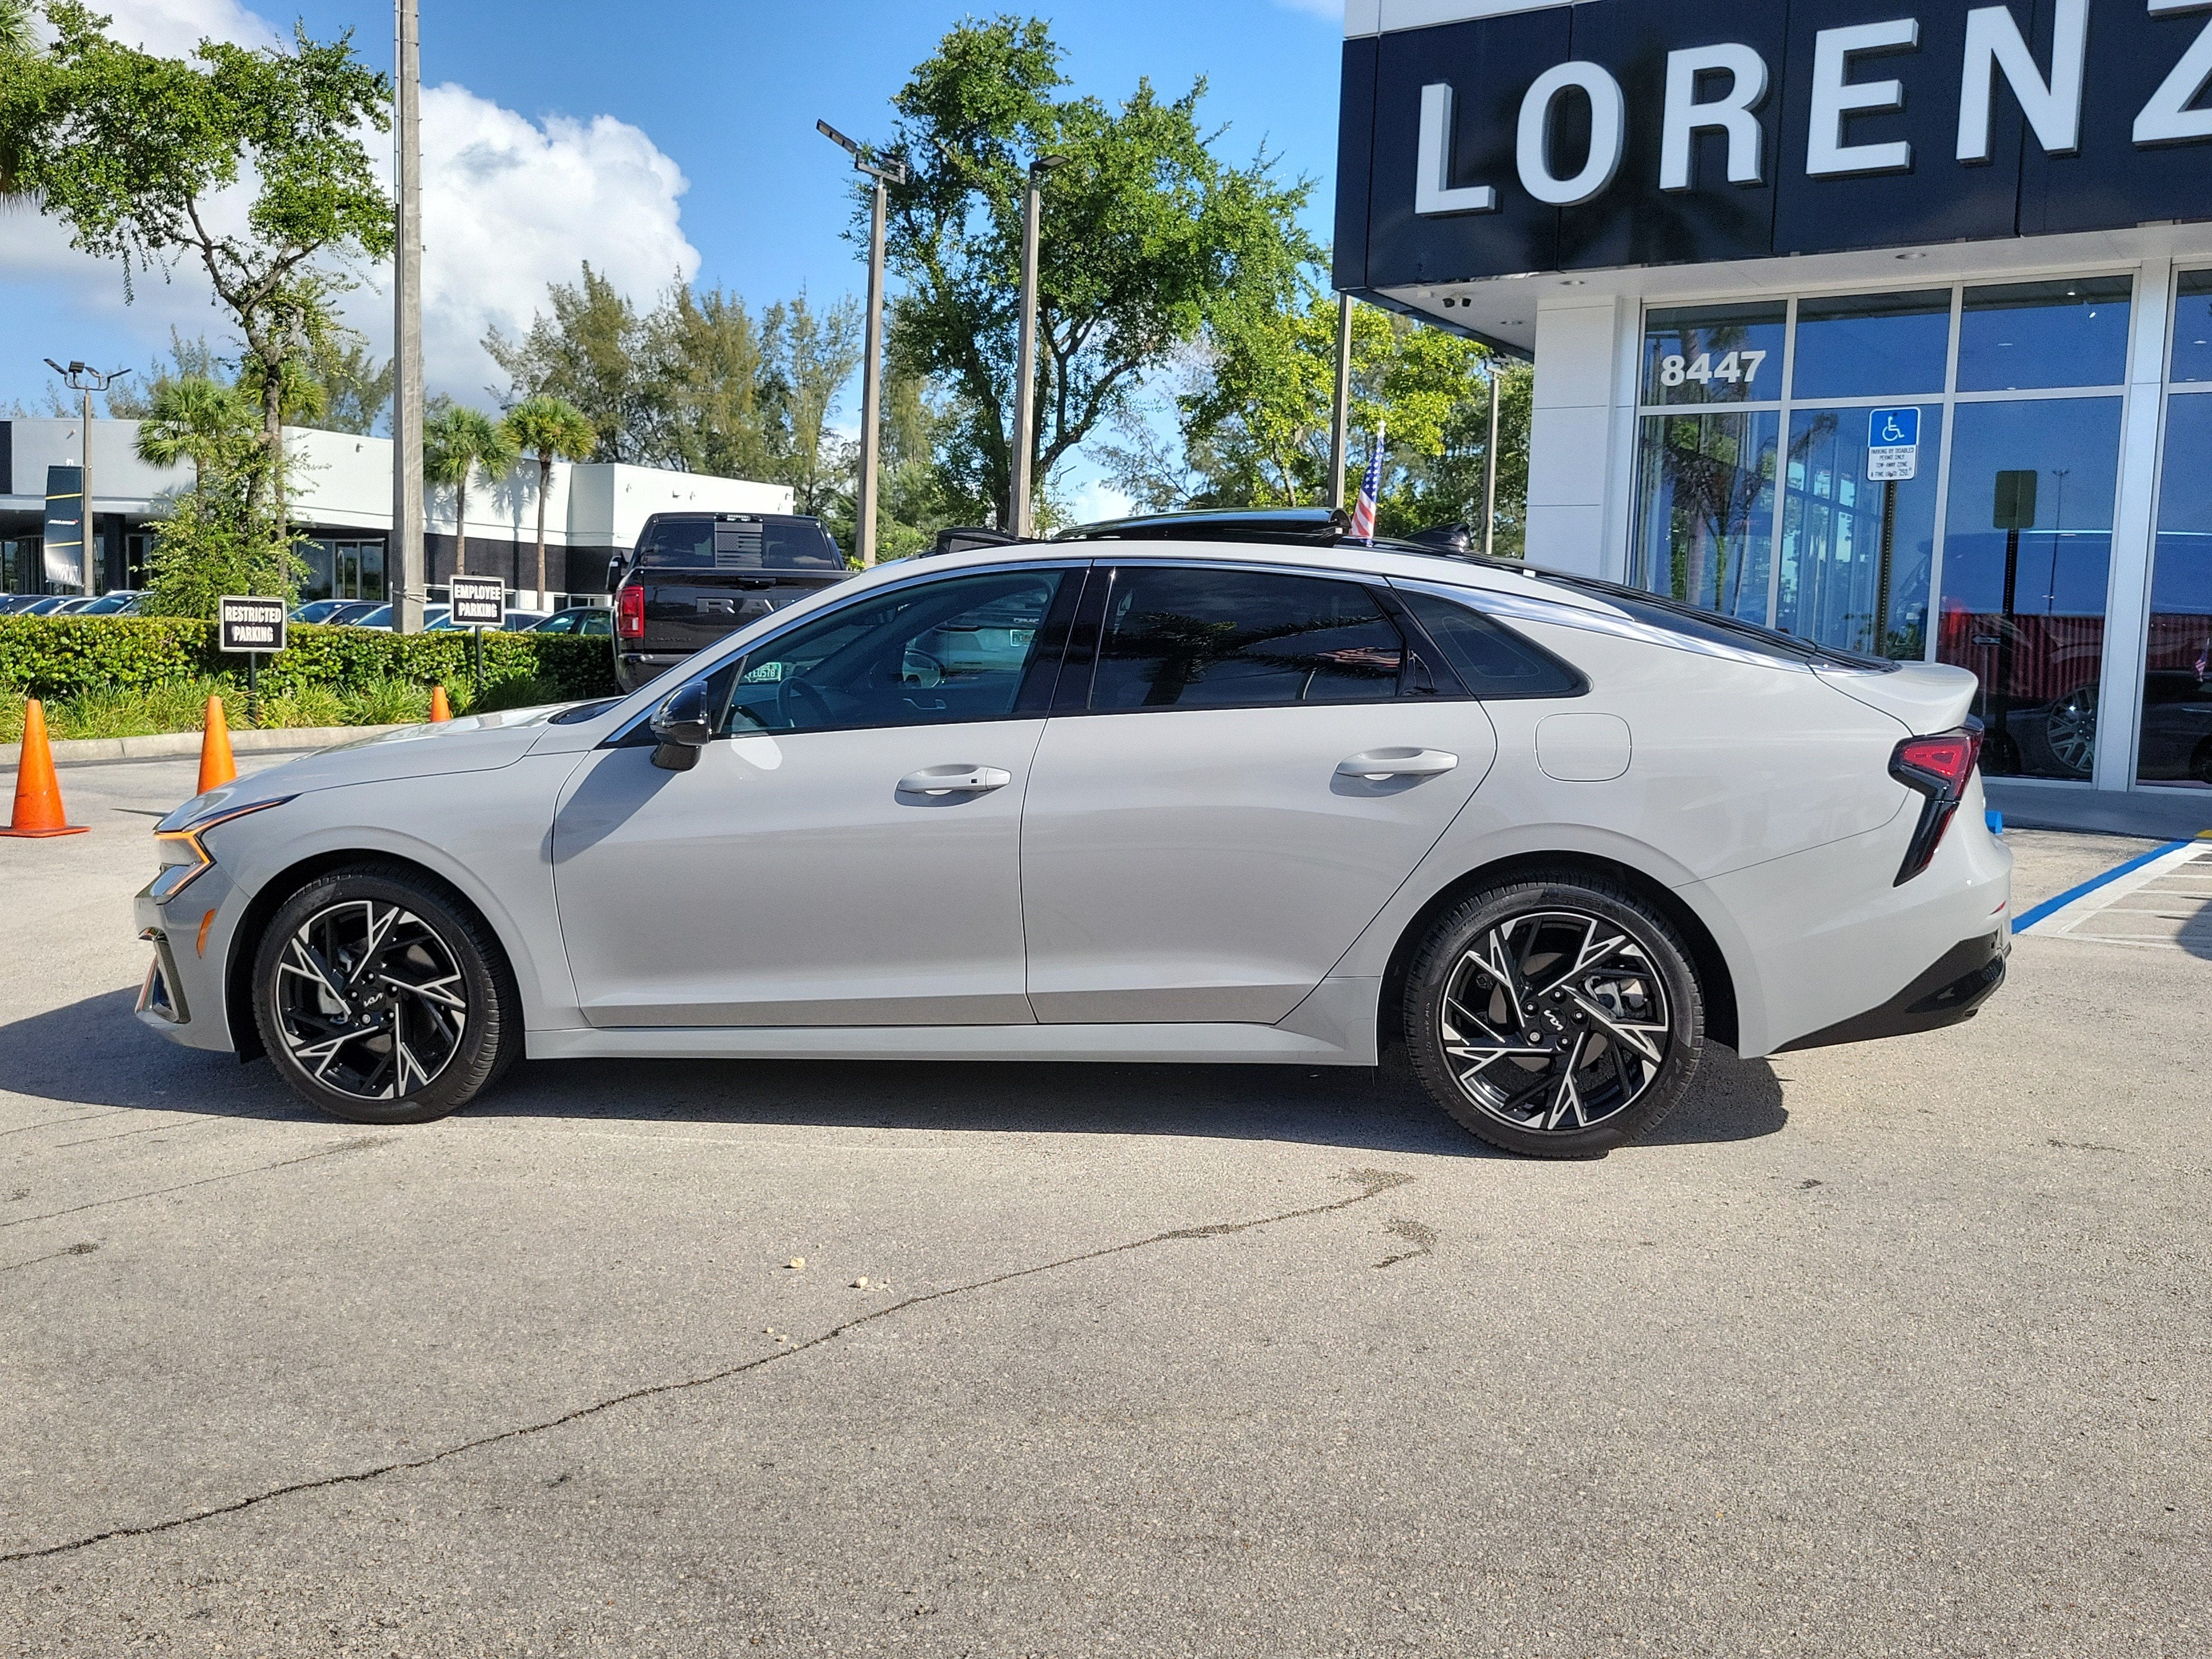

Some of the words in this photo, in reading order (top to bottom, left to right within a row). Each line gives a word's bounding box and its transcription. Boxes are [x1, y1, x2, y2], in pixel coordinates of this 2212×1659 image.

[1661, 350, 1766, 386] 8447
[454, 584, 501, 600] EMPLOYEE
[225, 606, 282, 623] RESTRICTED
[458, 602, 498, 618] PARKING
[233, 626, 274, 642] PARKING
